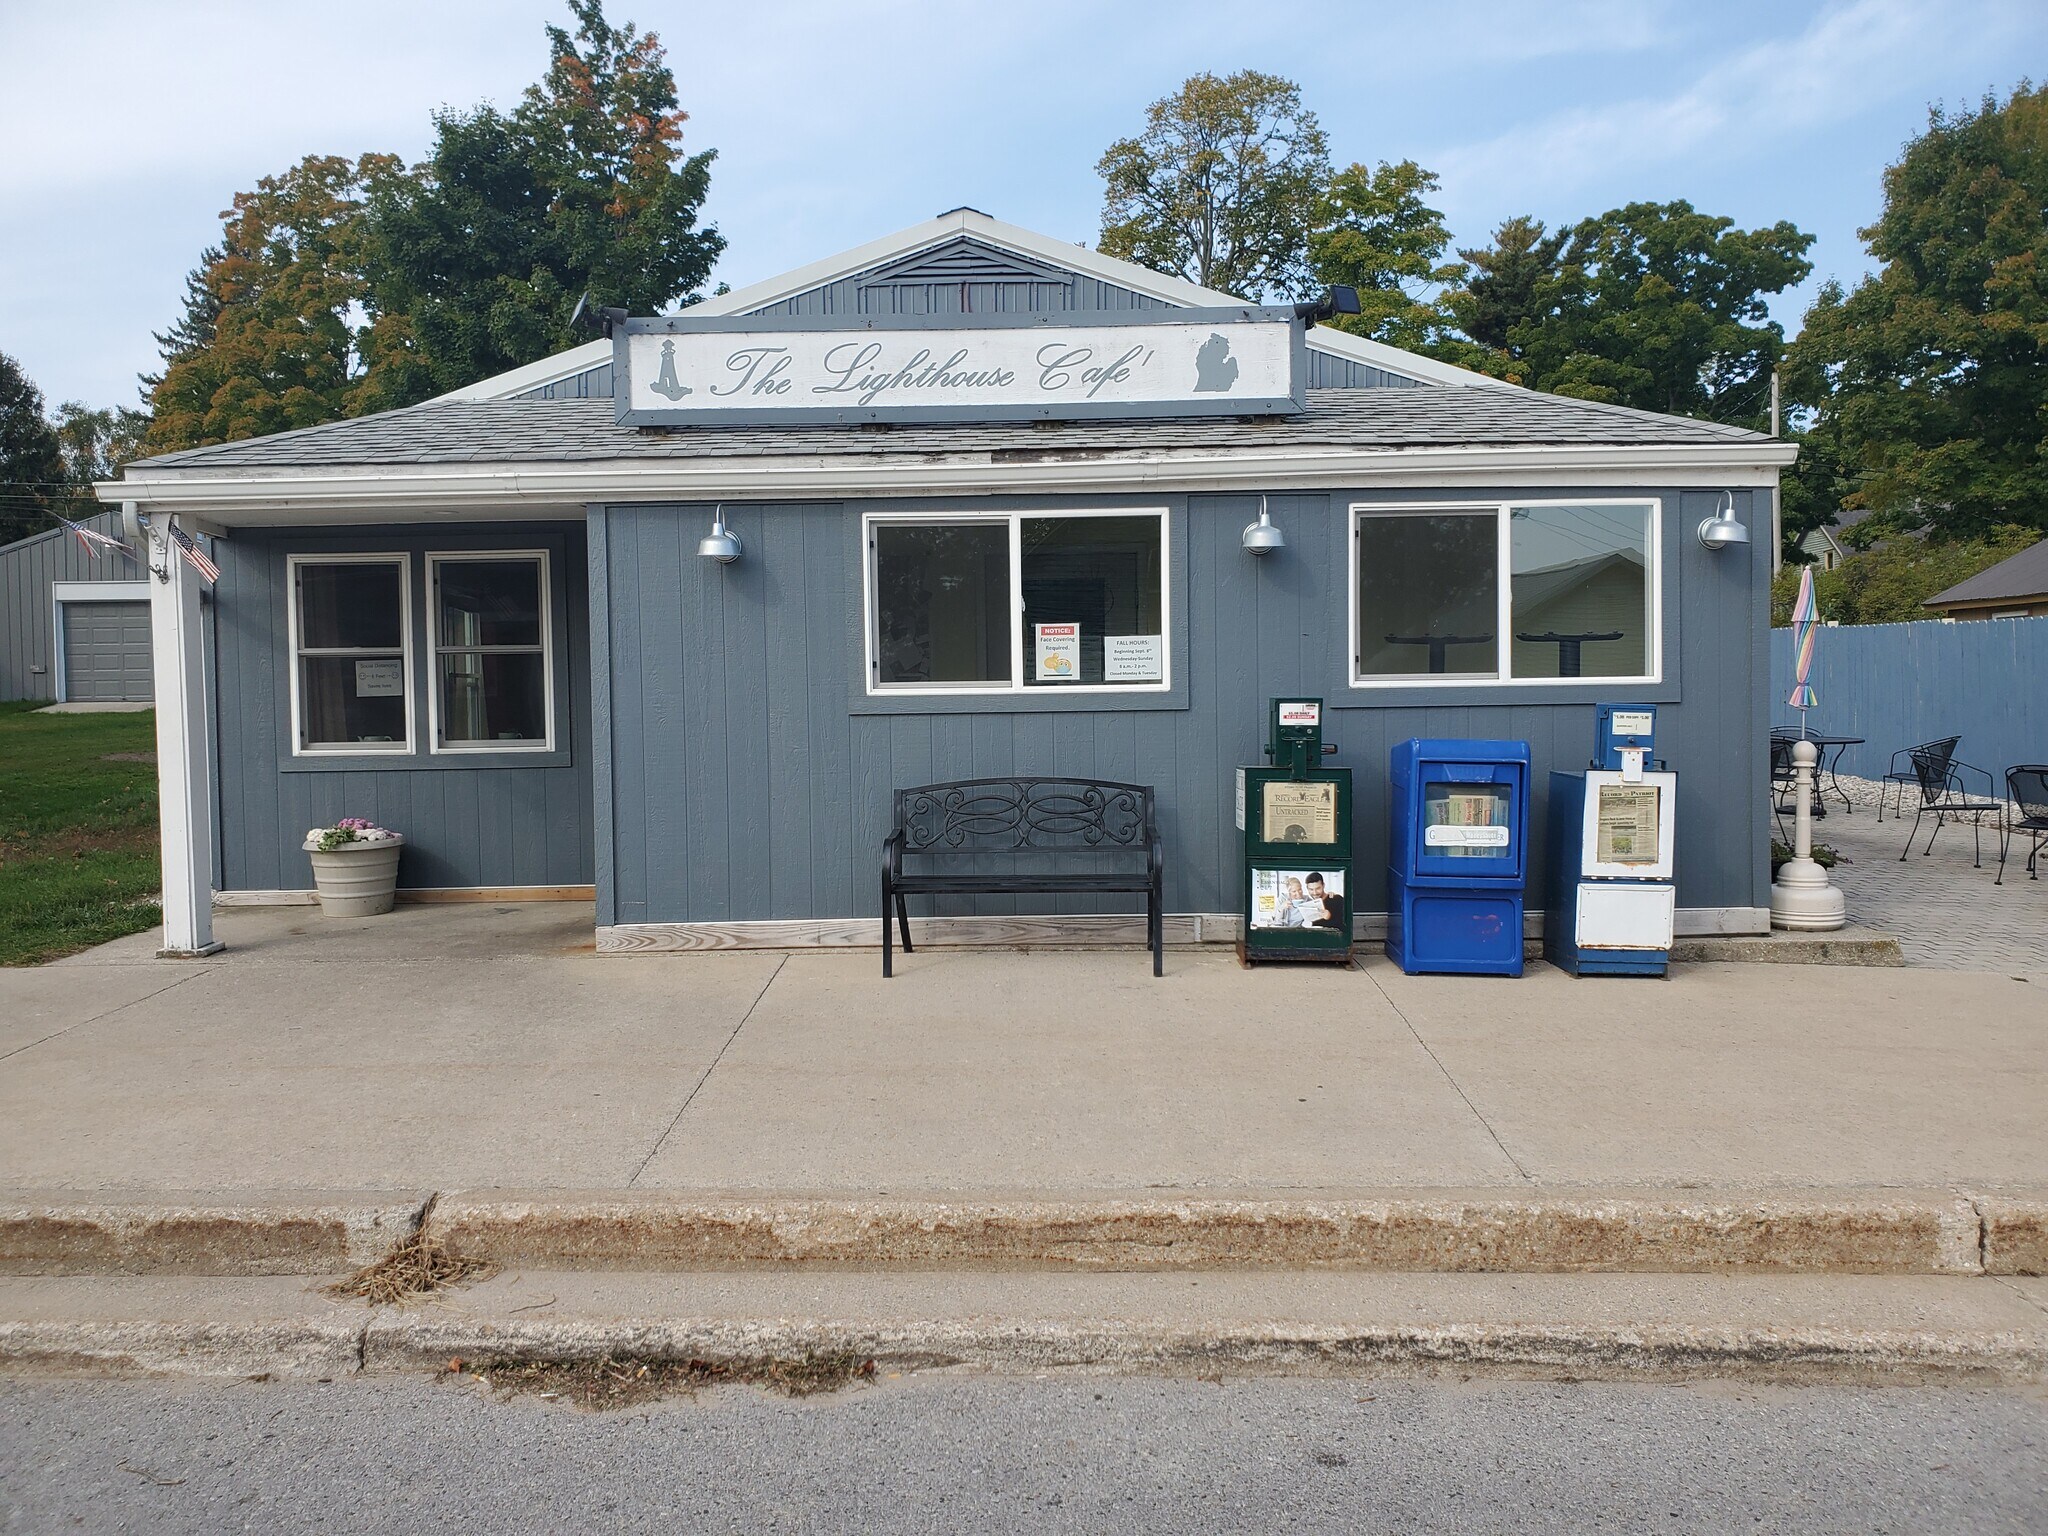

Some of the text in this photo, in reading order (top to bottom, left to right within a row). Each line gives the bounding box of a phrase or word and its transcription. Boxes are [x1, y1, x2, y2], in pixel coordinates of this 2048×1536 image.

[709, 347, 792, 396] The
[811, 342, 1015, 406] Lighthouse
[1275, 806, 1309, 815] UNTRACKED
